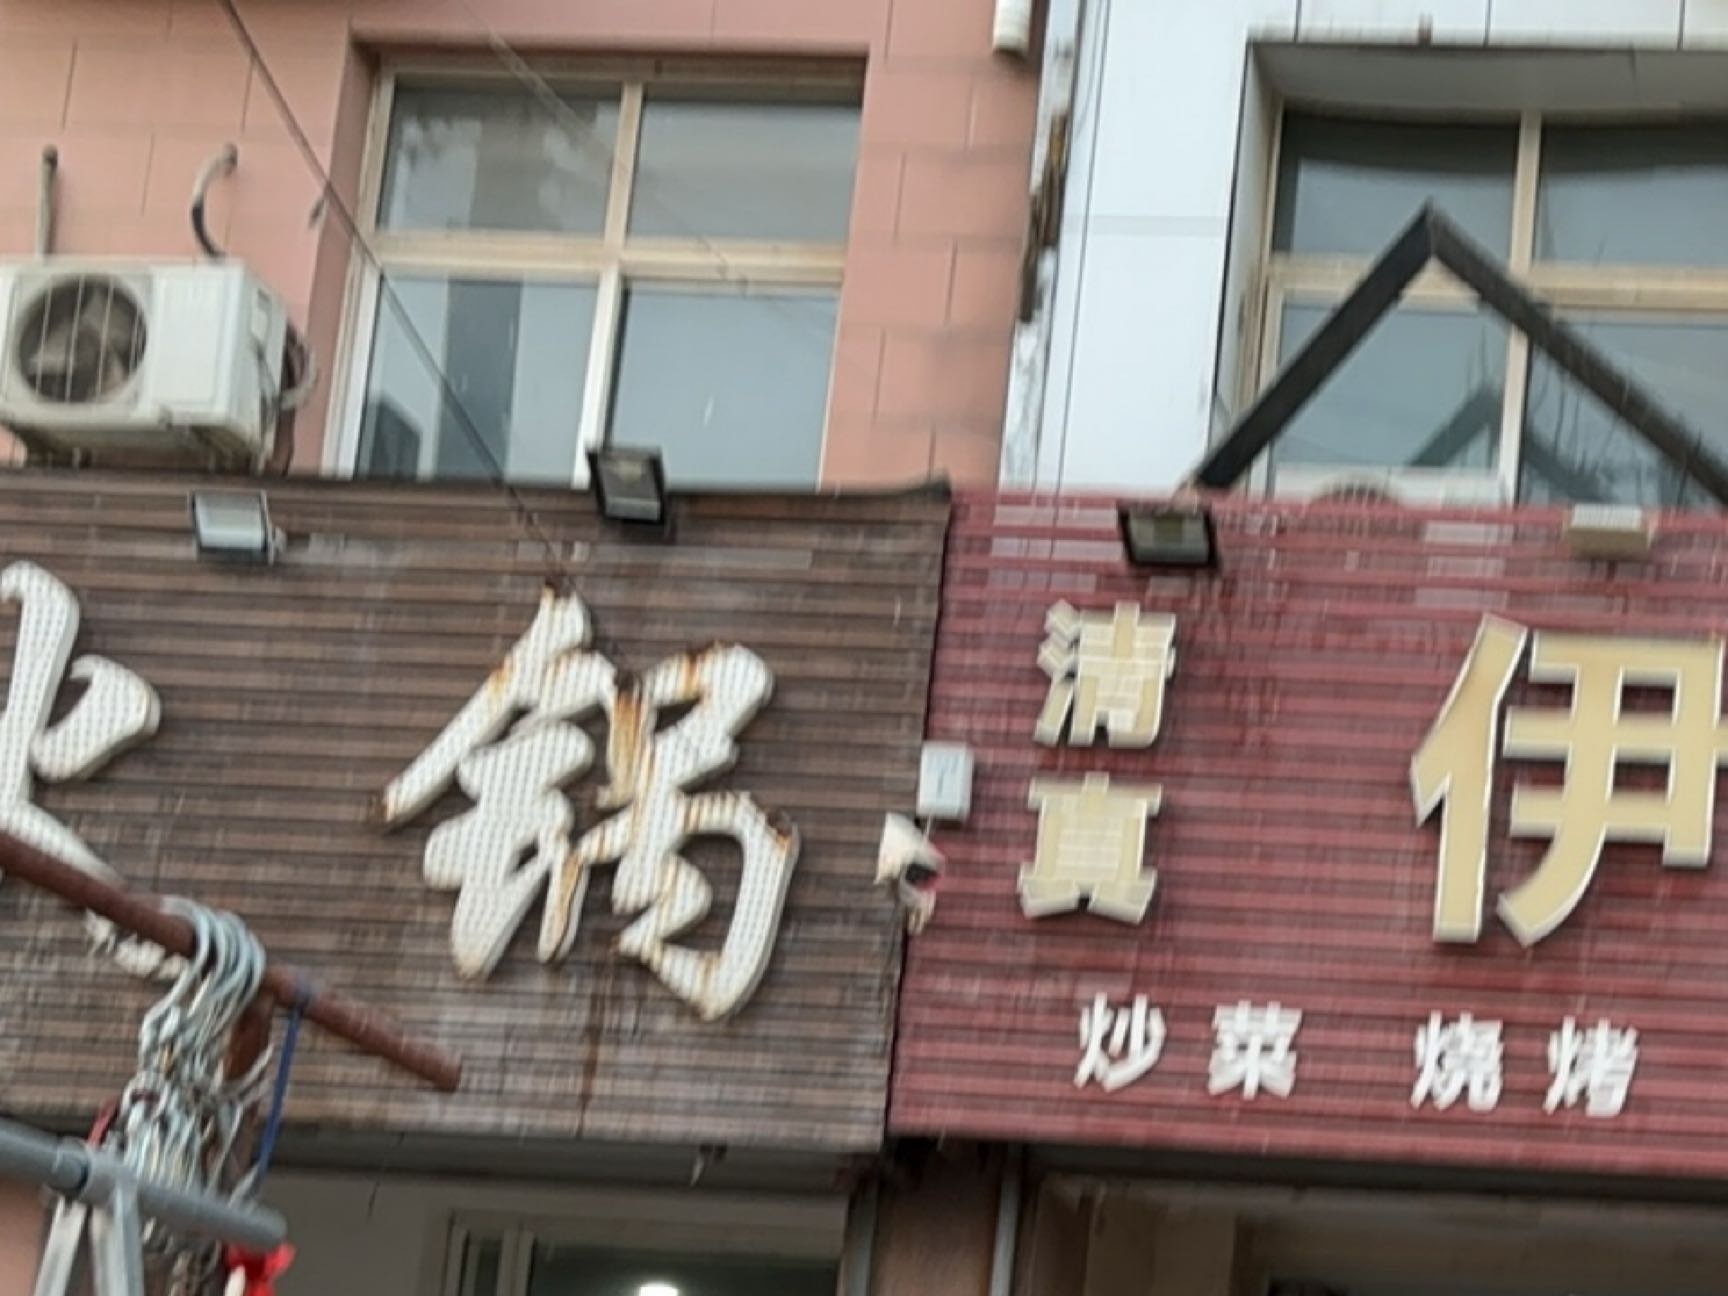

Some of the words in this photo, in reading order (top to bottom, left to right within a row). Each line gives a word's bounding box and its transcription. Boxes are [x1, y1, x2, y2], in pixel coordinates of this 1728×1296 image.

[1020, 599, 1177, 925] 清真
[1074, 993, 1303, 1098] 炒菜
[1410, 1011, 1639, 1117] 烧烤
